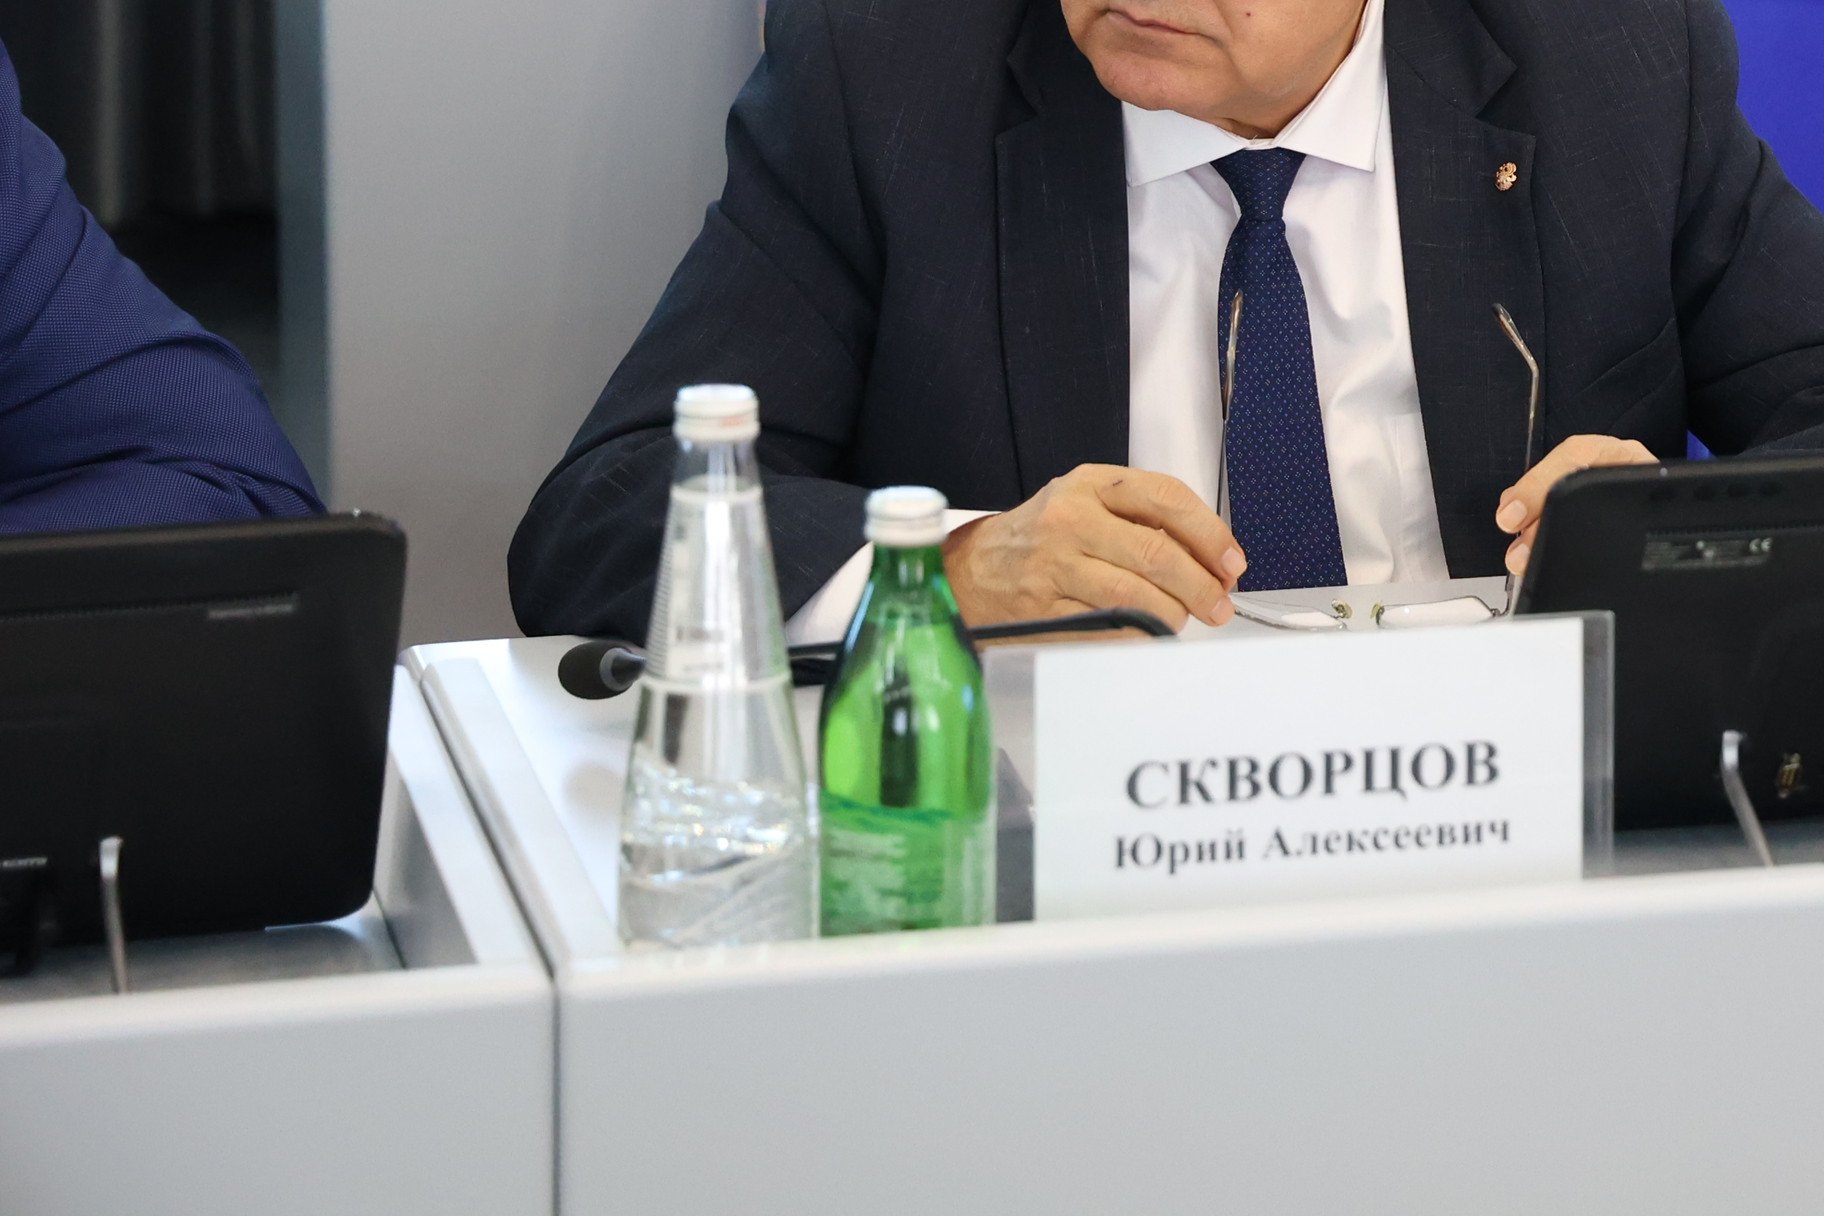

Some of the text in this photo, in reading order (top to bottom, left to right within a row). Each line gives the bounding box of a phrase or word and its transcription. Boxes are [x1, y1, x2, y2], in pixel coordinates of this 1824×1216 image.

[1124, 740, 1502, 810] СКВОРЦОВ
[1114, 818, 1511, 876] Юрий Алексеевич
